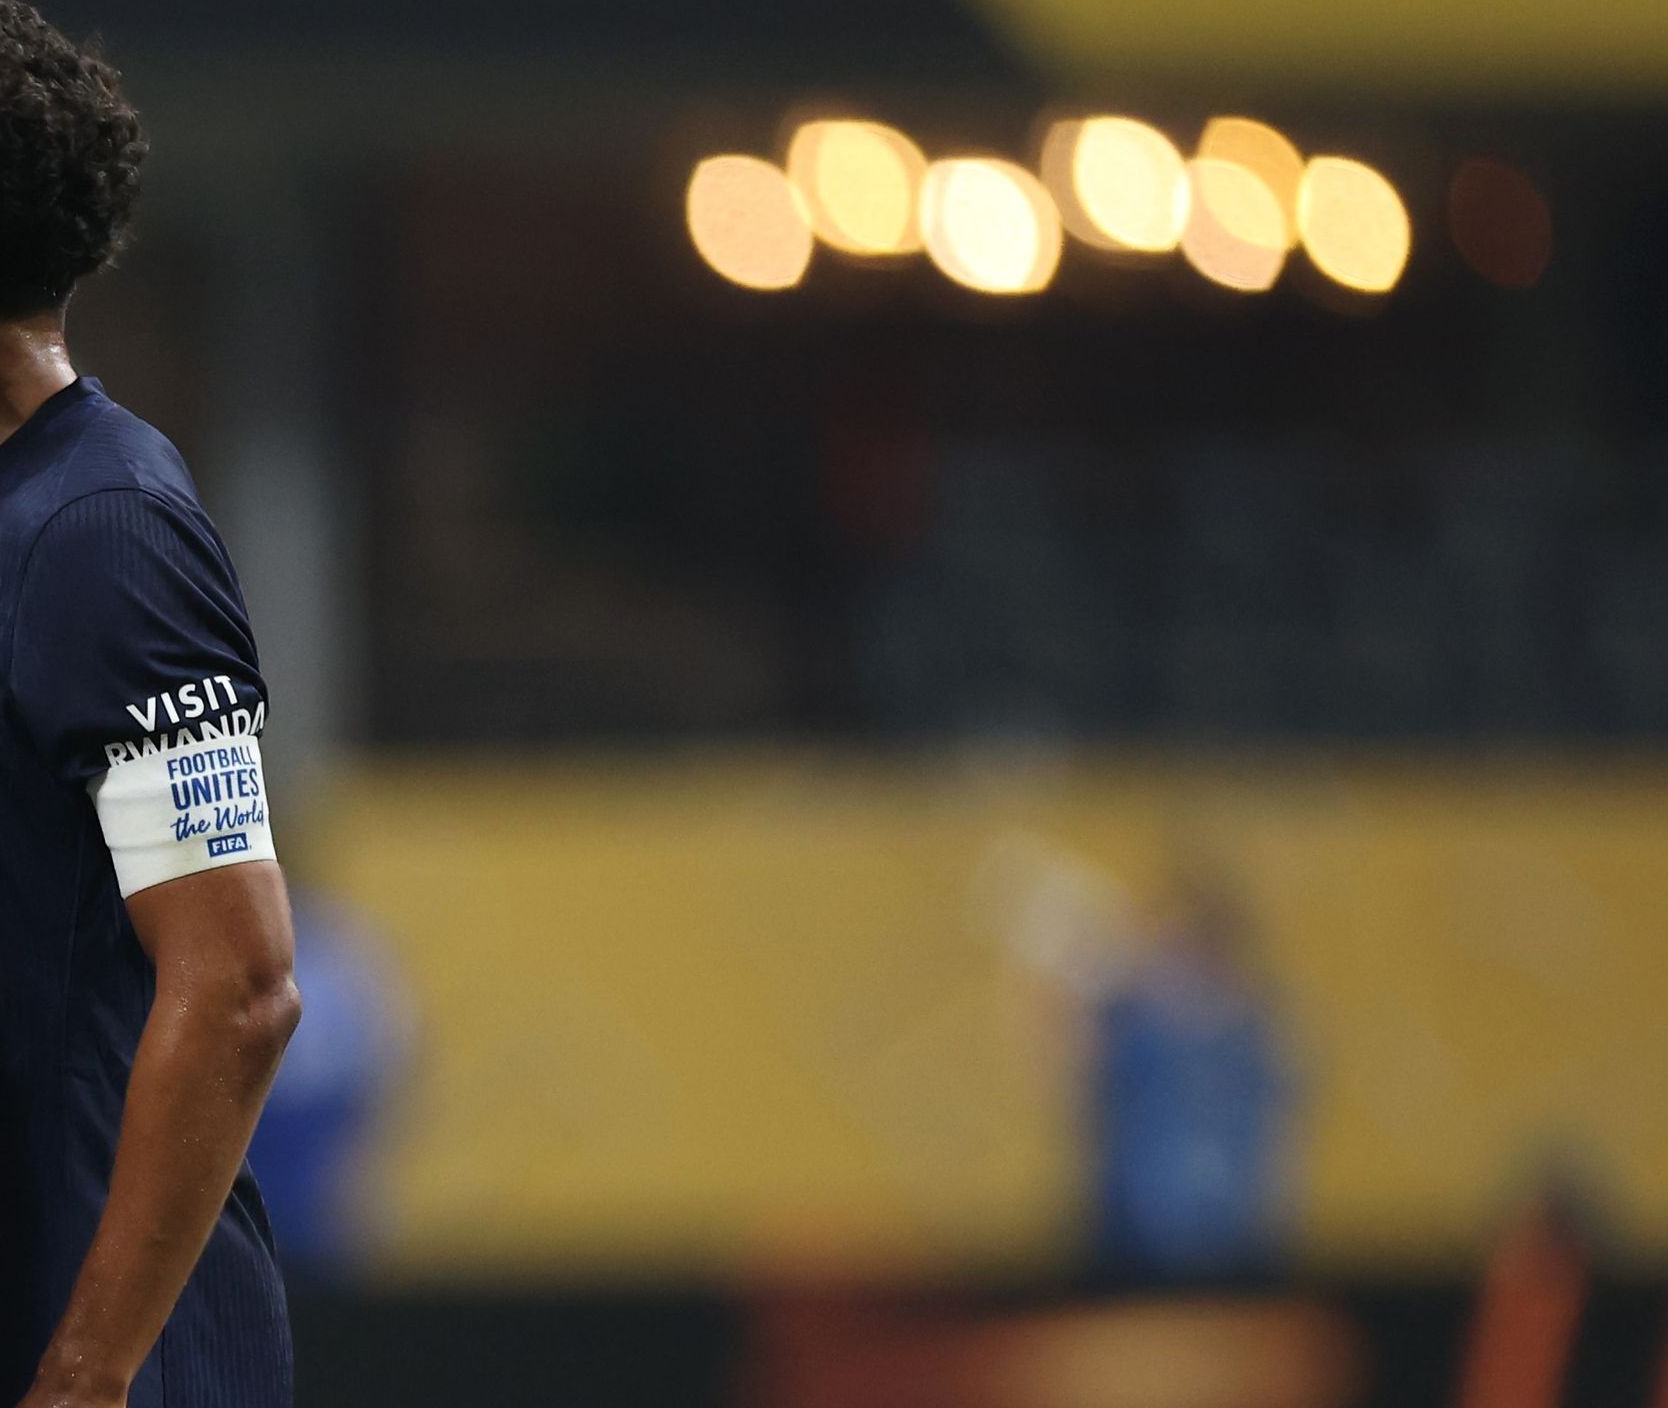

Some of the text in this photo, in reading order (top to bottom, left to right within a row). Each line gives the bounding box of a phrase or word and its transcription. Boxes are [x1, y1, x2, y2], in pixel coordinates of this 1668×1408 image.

[125, 675, 238, 733] VISIT
[167, 745, 257, 781] FOOTBALL
[171, 768, 260, 811] UNITES
[170, 800, 265, 843] the World
[211, 836, 248, 855] FIFA
